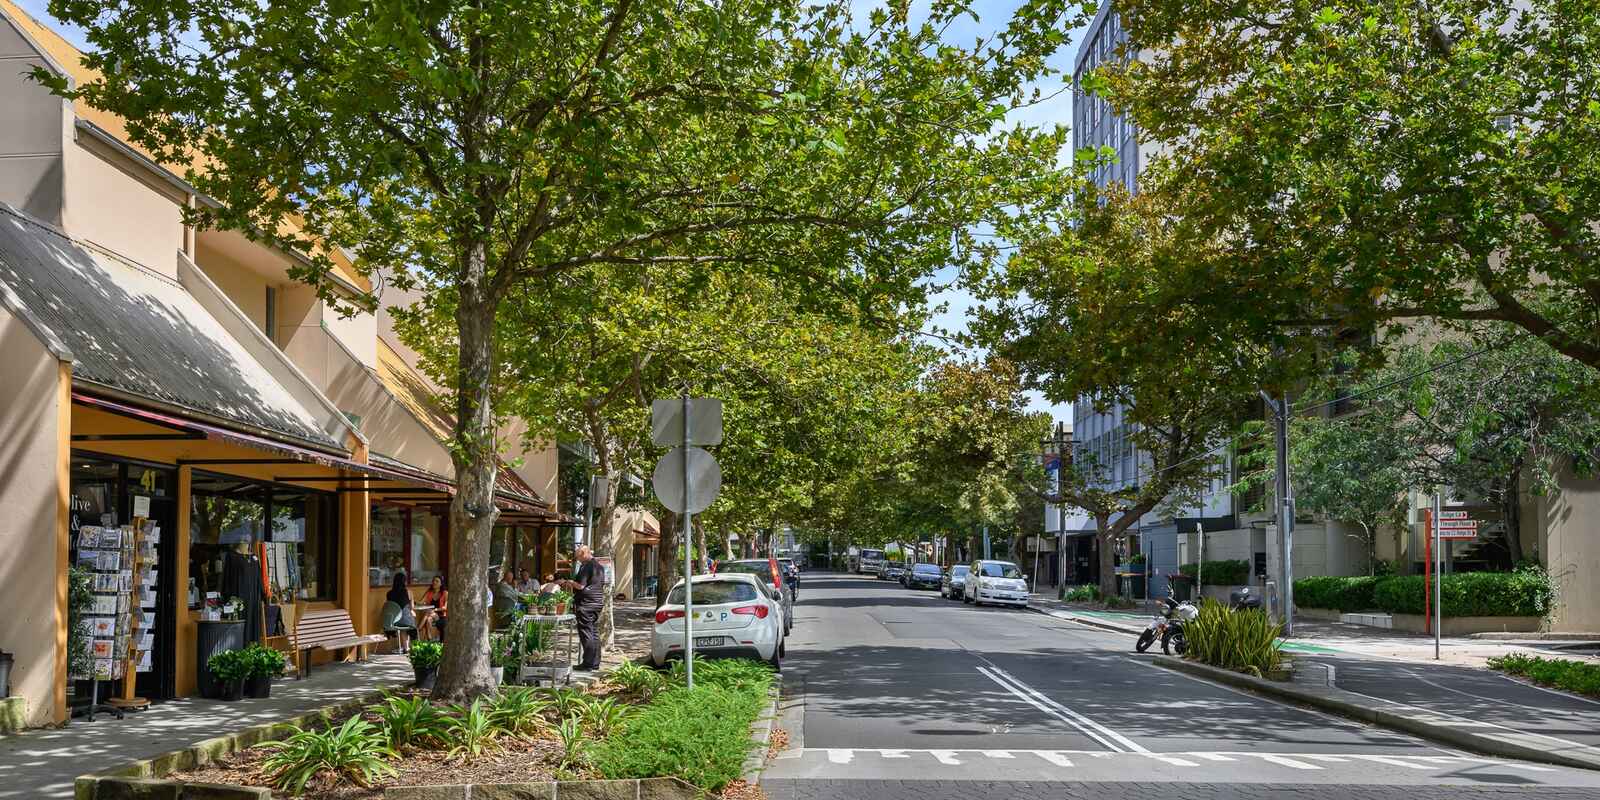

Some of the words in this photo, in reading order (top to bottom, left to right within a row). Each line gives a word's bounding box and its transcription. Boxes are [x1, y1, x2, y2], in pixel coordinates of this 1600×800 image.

[140, 468, 156, 491] 41
[71, 514, 80, 530] &
[720, 612, 728, 621] P
